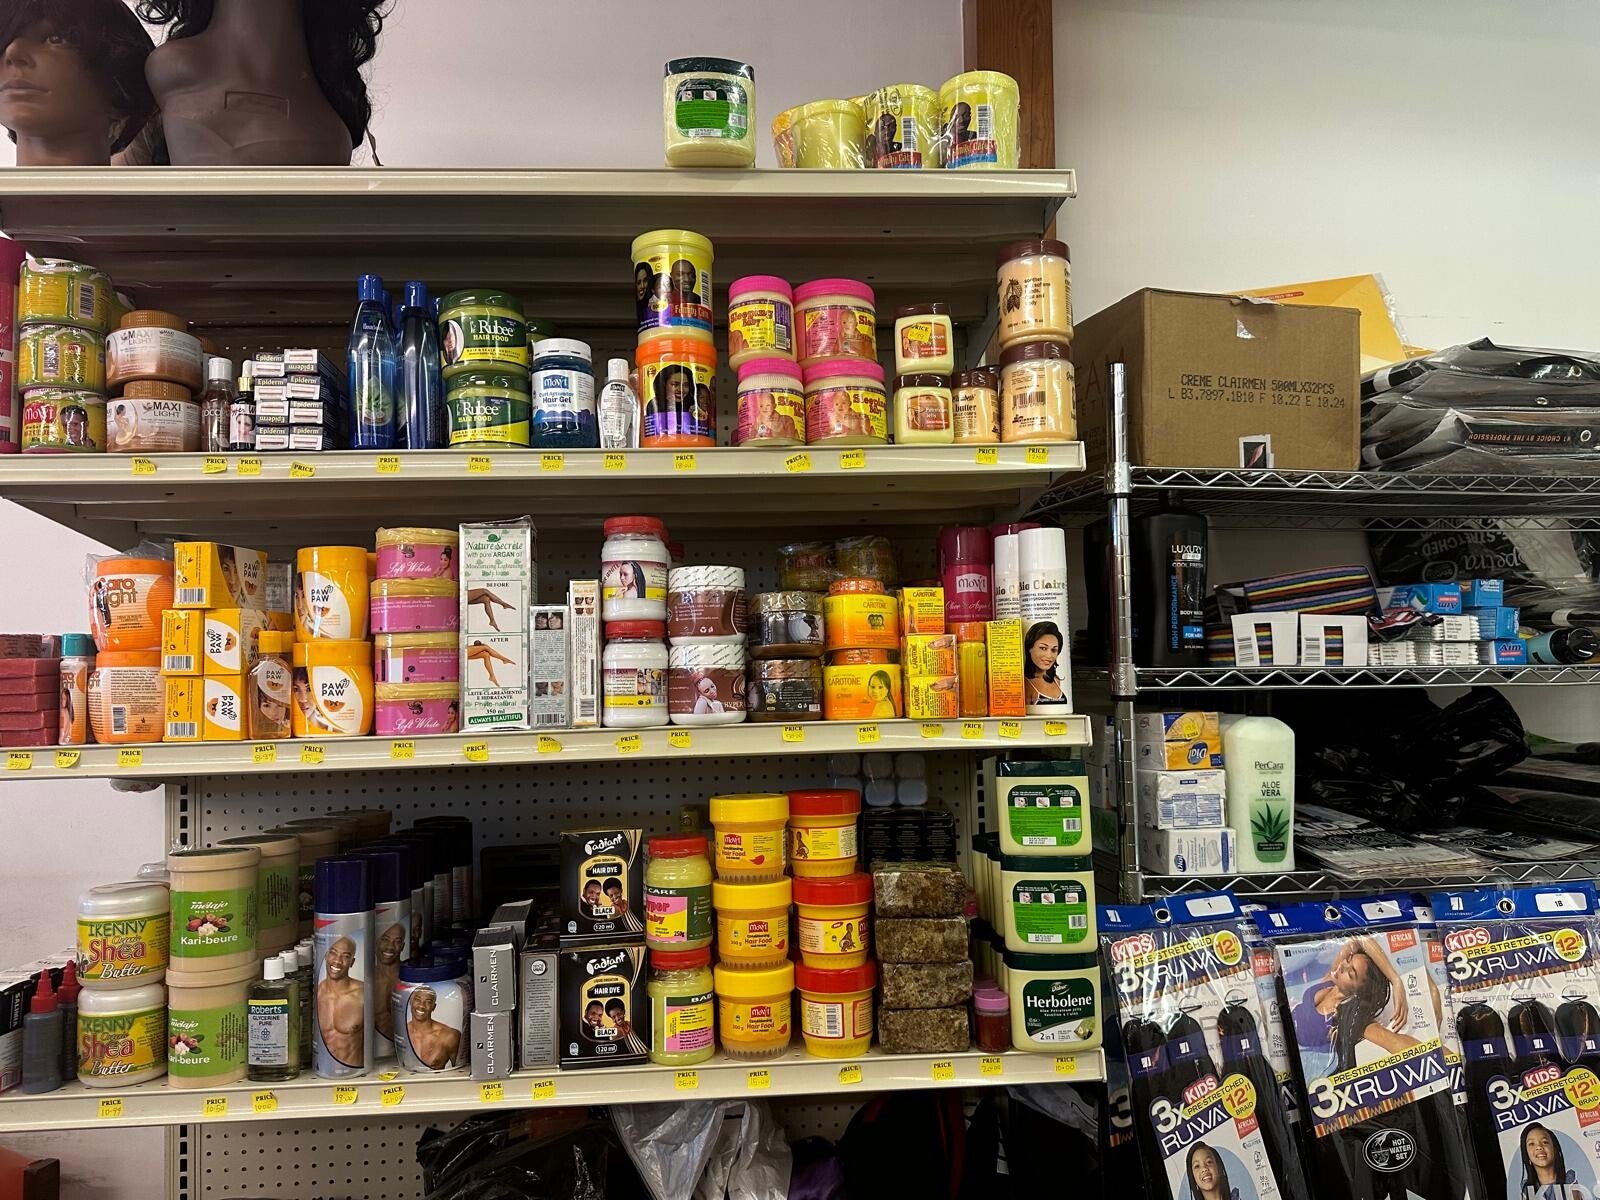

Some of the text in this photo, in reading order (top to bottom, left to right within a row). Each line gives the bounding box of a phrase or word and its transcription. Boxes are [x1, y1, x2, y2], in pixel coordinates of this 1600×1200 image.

[479, 320, 514, 336] Rubee
[1181, 374, 1334, 394] CREME CLAIRMEN 500MLX32PCS
[1169, 388, 1175, 399] L
[1259, 393, 1265, 404] F
[1272, 394, 1300, 406] 10.22
[1306, 396, 1311, 406] E
[1317, 397, 1345, 408] 10.24
[153, 402, 180, 410] MAXI
[464, 402, 498, 415] Rubee
[956, 404, 976, 412] butter
[786, 455, 802, 464] PRICE
[294, 464, 313, 472] PRICE
[465, 542, 494, 550] Nature
[1172, 545, 1203, 553] LUXURY
[244, 563, 258, 571] PAW
[407, 562, 432, 572] White
[244, 571, 258, 579] PAW
[1034, 579, 1066, 590] Claire
[1501, 643, 1521, 651] Aim
[829, 677, 861, 686] CAROTONE
[416, 716, 440, 729] White
[1189, 747, 1207, 760] Dial
[1255, 761, 1284, 769] PerCara
[1262, 781, 1280, 789] ALOE
[89, 919, 146, 937] IKENNY
[181, 934, 238, 945] Kari-beure
[1390, 934, 1413, 942] AFRICAN
[1448, 931, 1487, 949] KIDS
[89, 939, 146, 962] Shea
[1134, 937, 1212, 967] PRE-STRETCHED
[1468, 934, 1552, 957] PRE-STRETCHED
[1224, 952, 1238, 960] BRAID
[1155, 951, 1221, 982] RUWA
[1447, 947, 1559, 980] 3x RUWA
[101, 964, 146, 979] Butter
[490, 950, 498, 1006] CLAIRMEN
[1027, 994, 1092, 1008] Herbolene
[251, 1006, 282, 1014] Roberts
[82, 1016, 135, 1032] IKENNY
[82, 1034, 134, 1058] Shea
[91, 1060, 134, 1075] Butter
[1334, 1044, 1427, 1084] PRE-STRETCHED BRAID
[1524, 1067, 1559, 1088] KIDS
[1185, 1077, 1217, 1103] KIDS
[1308, 1056, 1444, 1119] 3x RUWA
[1526, 1072, 1590, 1098] PRE-STRETCHED
[1187, 1077, 1244, 1115] PRE-STRETCHED
[1489, 1080, 1526, 1110] 3x
[1578, 1095, 1599, 1106] BRAID
[1235, 1101, 1254, 1116] BRAID
[1497, 1095, 1570, 1129] RUWA
[1580, 1110, 1599, 1118] AFRICAN
[1151, 1100, 1191, 1134] 3x
[1161, 1107, 1228, 1155] RUWA
[1390, 1145, 1411, 1153] WATER
[1392, 1138, 1405, 1146] HOT
